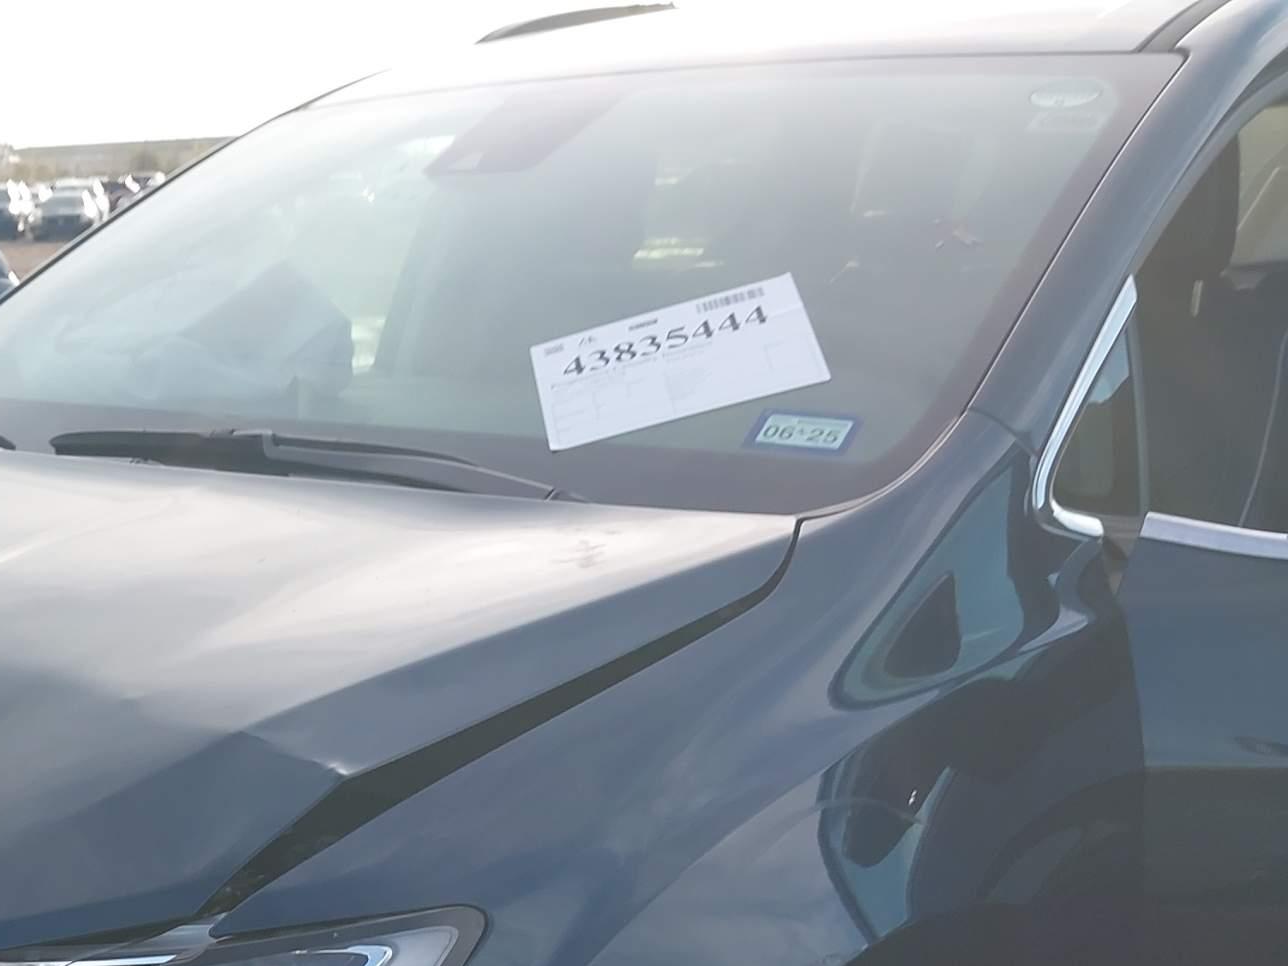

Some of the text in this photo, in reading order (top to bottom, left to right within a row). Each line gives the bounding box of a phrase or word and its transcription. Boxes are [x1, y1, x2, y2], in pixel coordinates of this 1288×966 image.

[563, 305, 769, 378] 43835444
[763, 424, 839, 444] 06 25
